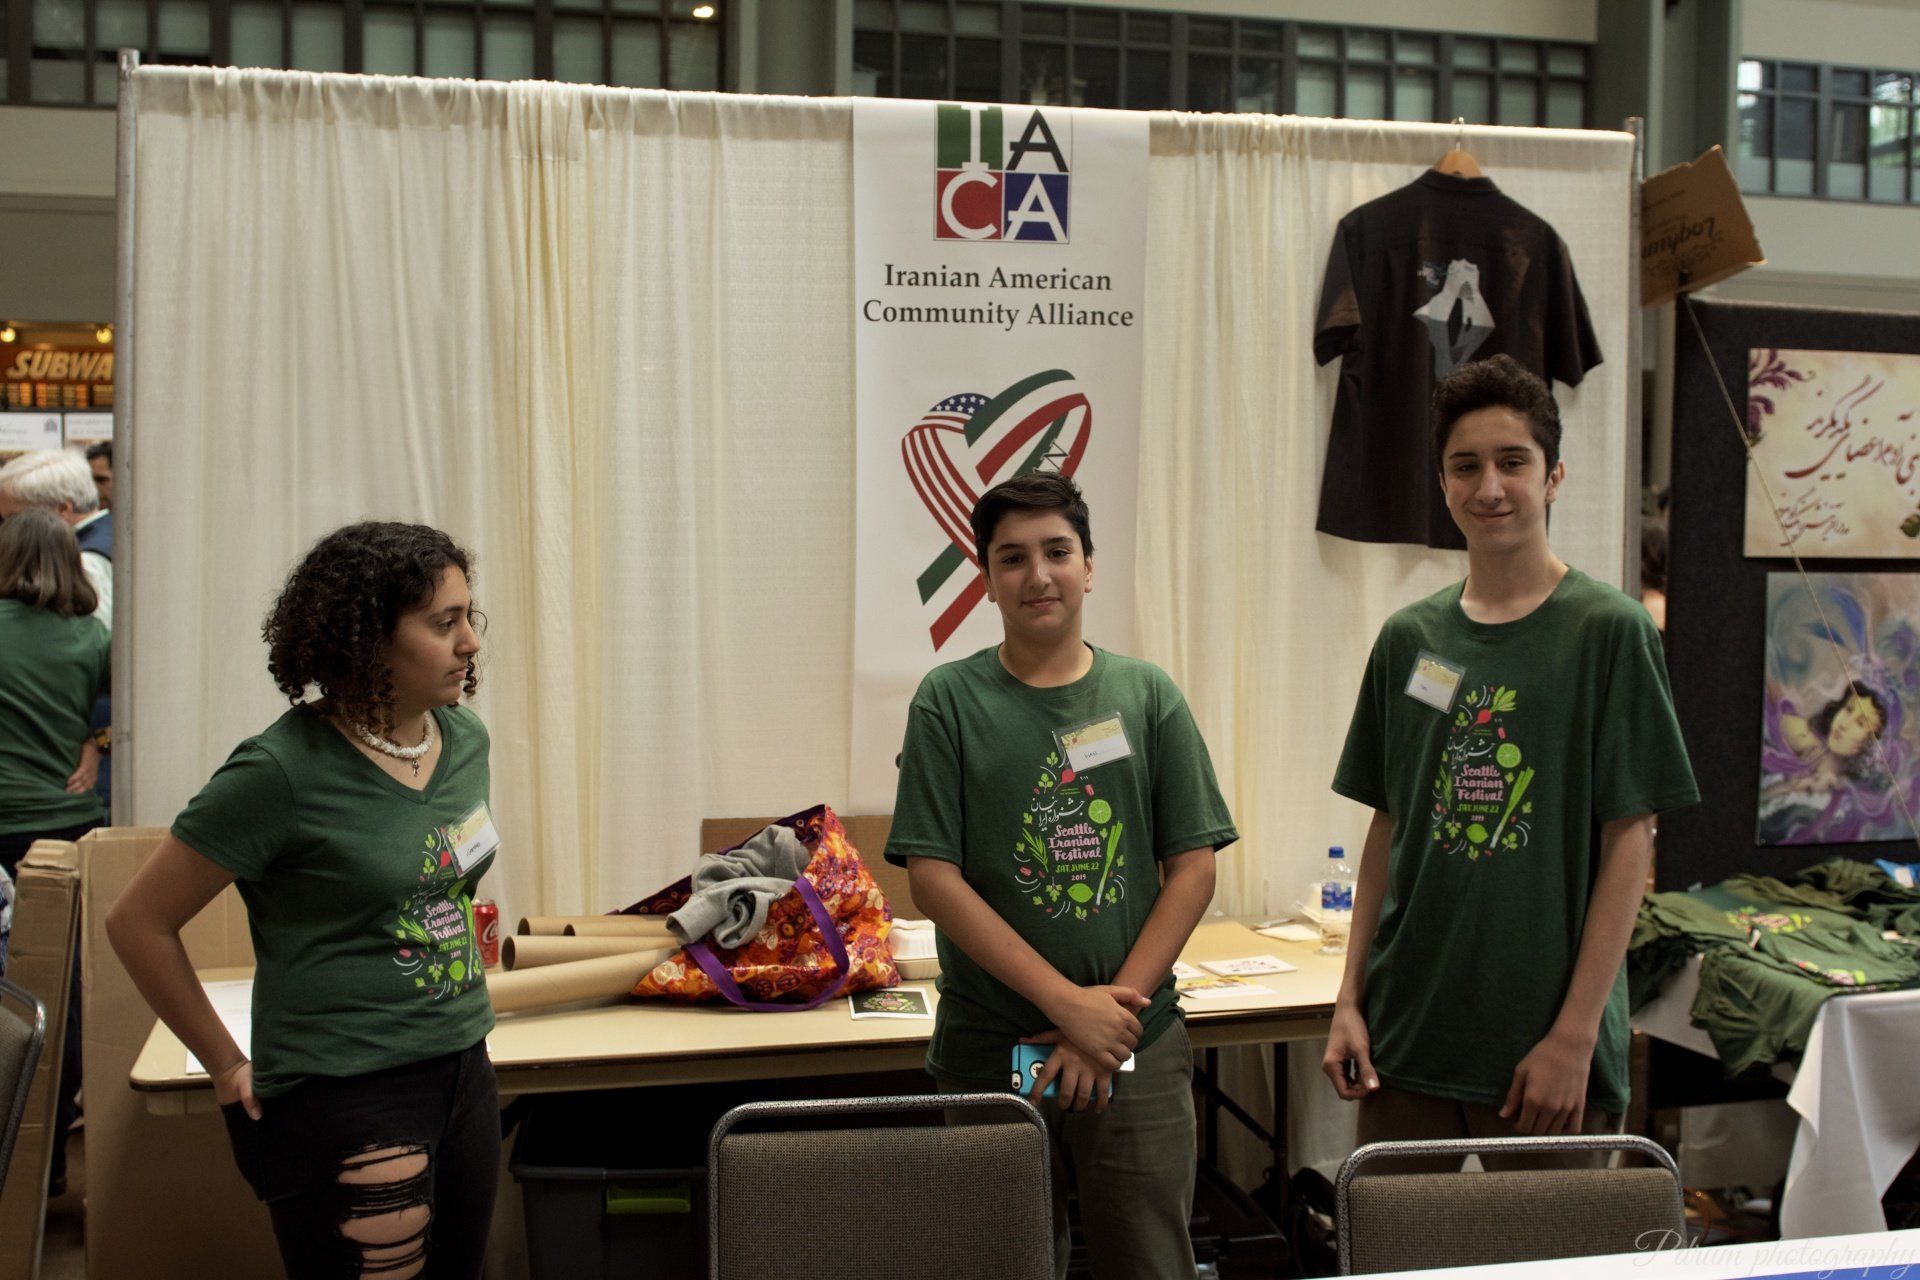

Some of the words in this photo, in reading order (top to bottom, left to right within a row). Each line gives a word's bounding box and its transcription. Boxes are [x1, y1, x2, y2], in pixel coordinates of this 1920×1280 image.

[884, 264, 980, 287] Iranian
[989, 266, 1112, 290] American
[863, 300, 1020, 331] Community
[1027, 303, 1134, 326] Alliance
[5, 350, 113, 381] SUBWA
[1461, 763, 1500, 777] Seattle
[1454, 775, 1504, 789] Iranian
[1456, 787, 1504, 801] Festival
[1055, 822, 1096, 838] Seattle
[1048, 835, 1100, 849] Iranian
[1052, 847, 1102, 861] Festival
[1070, 862, 1090, 872] JUNE
[1091, 861, 1100, 870] 22
[1071, 873, 1087, 881] 2019
[421, 910, 463, 931] Iranian
[430, 920, 467, 940] Festival
